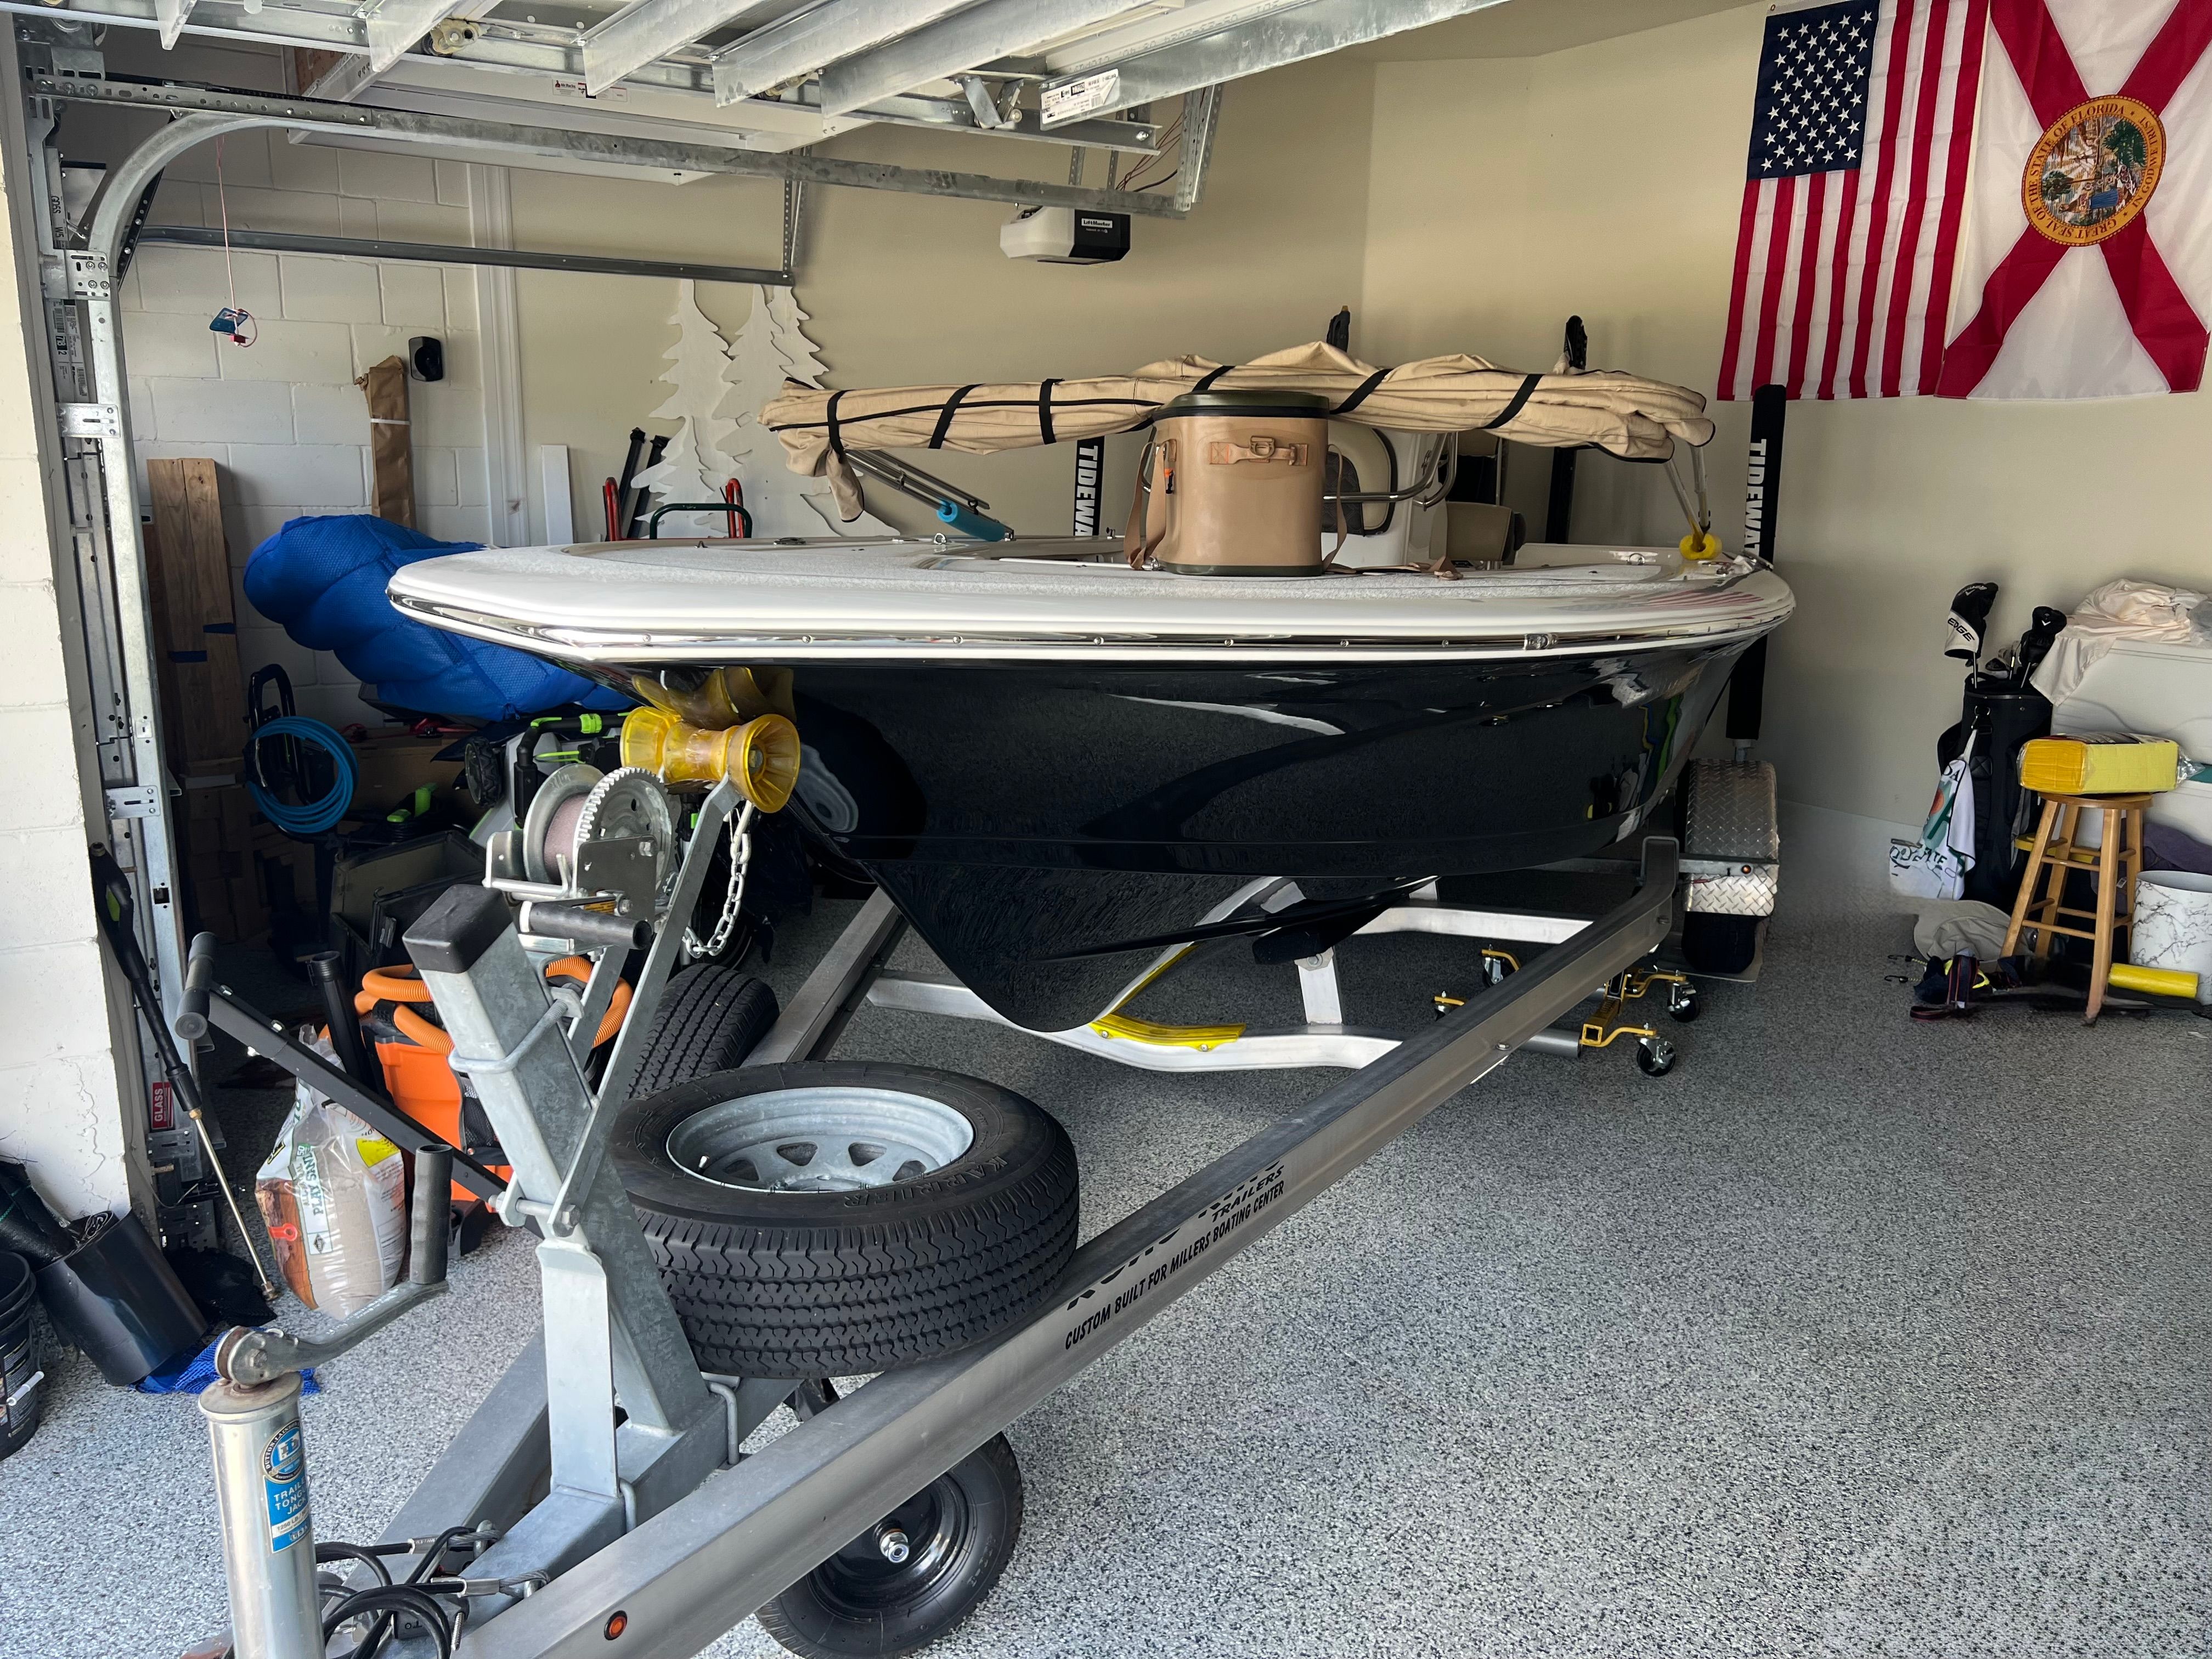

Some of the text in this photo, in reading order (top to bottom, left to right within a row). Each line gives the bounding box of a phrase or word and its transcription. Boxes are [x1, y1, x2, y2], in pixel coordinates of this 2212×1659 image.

[2028, 103, 2125, 239] GREAT SEAL OF THE STATE OF FLORIDA
[2131, 116, 2158, 208] IN GOD WE TRUST
[1947, 617, 1975, 642] EDGE
[154, 1088, 163, 1122] GLASS
[297, 1145, 306, 1156] 50
[309, 1184, 324, 1216] PLAY
[843, 1156, 1009, 1208] KARRIER
[1211, 1165, 1284, 1222] TRAILERS
[1065, 1304, 1111, 1350] CUSTOM
[1114, 1278, 1146, 1314] BUILT
[1147, 1263, 1167, 1290] FOR
[1170, 1233, 1211, 1274] MILLERS
[1212, 1203, 1251, 1243] BOATING
[1253, 1180, 1284, 1214] CENTER
